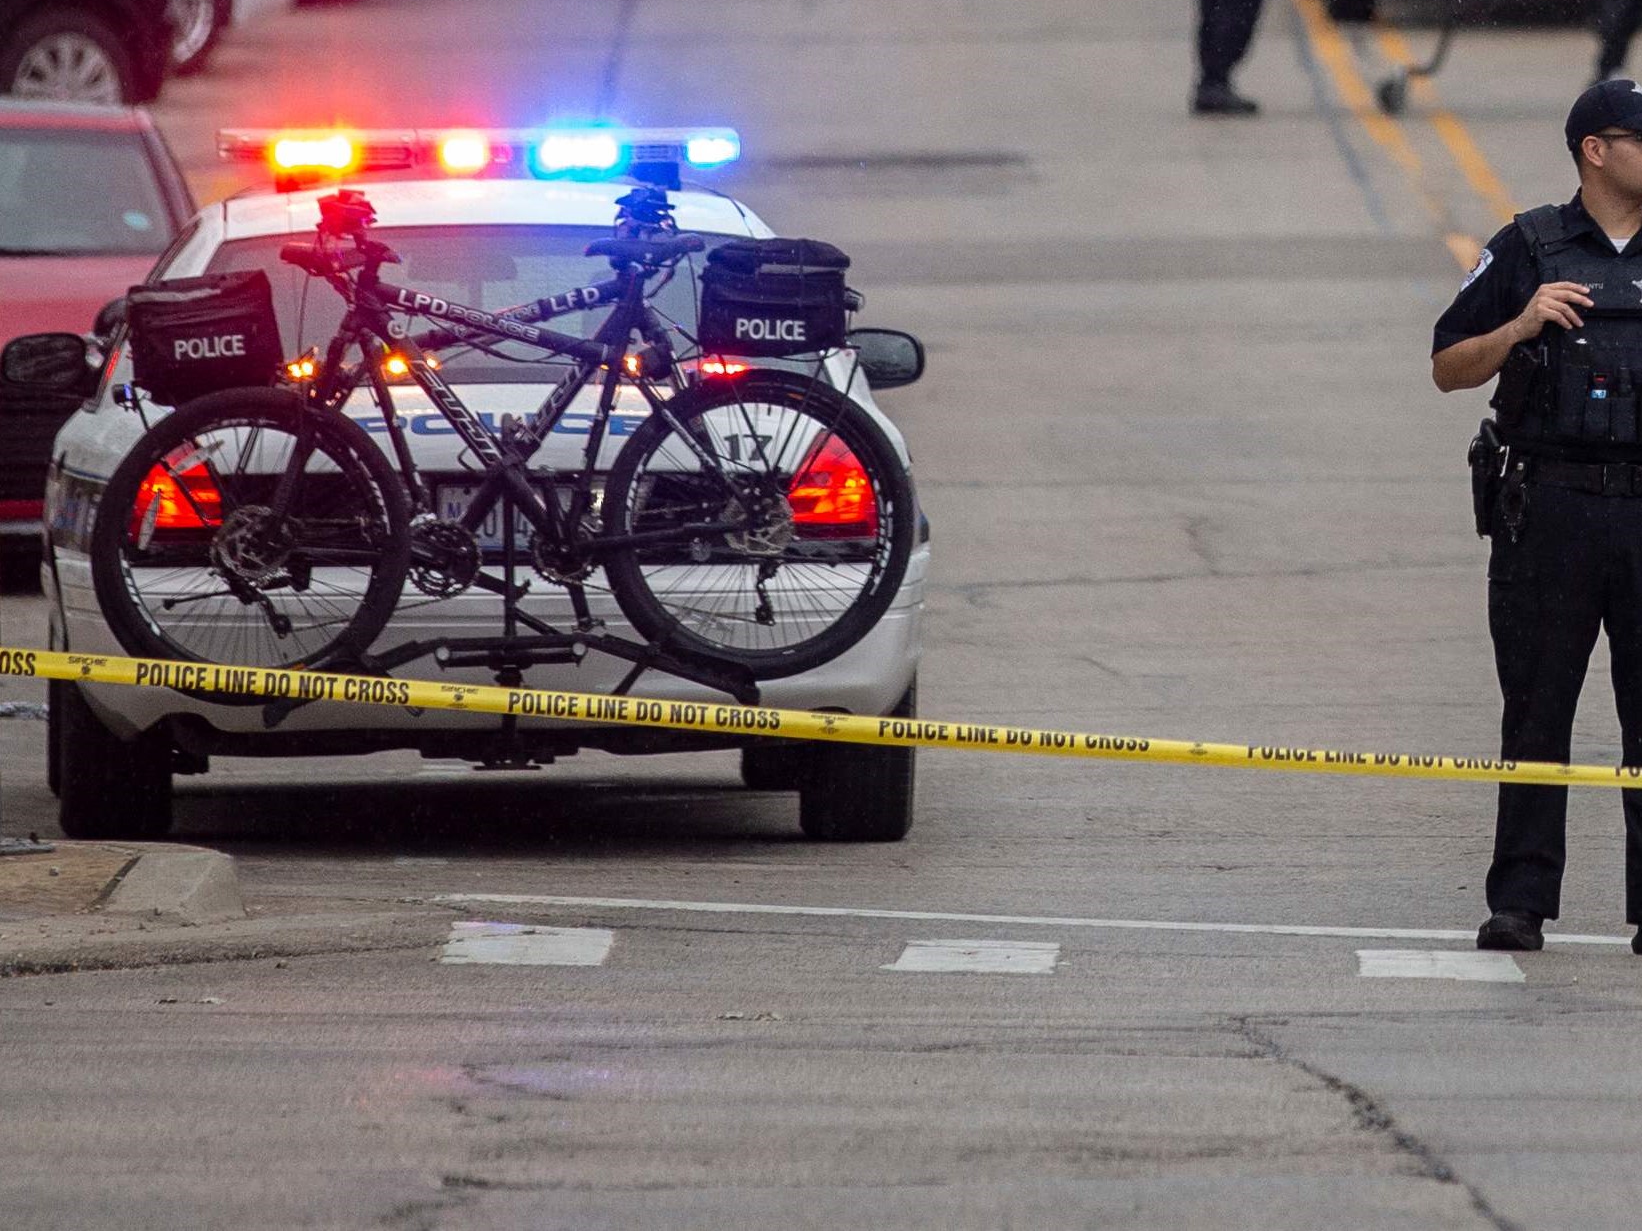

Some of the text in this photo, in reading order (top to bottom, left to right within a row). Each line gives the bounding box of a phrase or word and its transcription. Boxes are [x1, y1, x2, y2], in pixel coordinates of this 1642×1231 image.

[397, 288, 448, 315] LPD
[735, 318, 806, 340] POLICE
[174, 335, 246, 360] POLICE
[724, 434, 773, 461] 17
[136, 662, 409, 705] POLICE LINE DO NOT CROSS
[508, 692, 781, 730] POLICE LINE DO NOT CROSS
[878, 720, 948, 741] POLICE
[956, 726, 998, 744] LINE
[1006, 729, 1032, 746] DO
[1040, 732, 1075, 748] NOT
